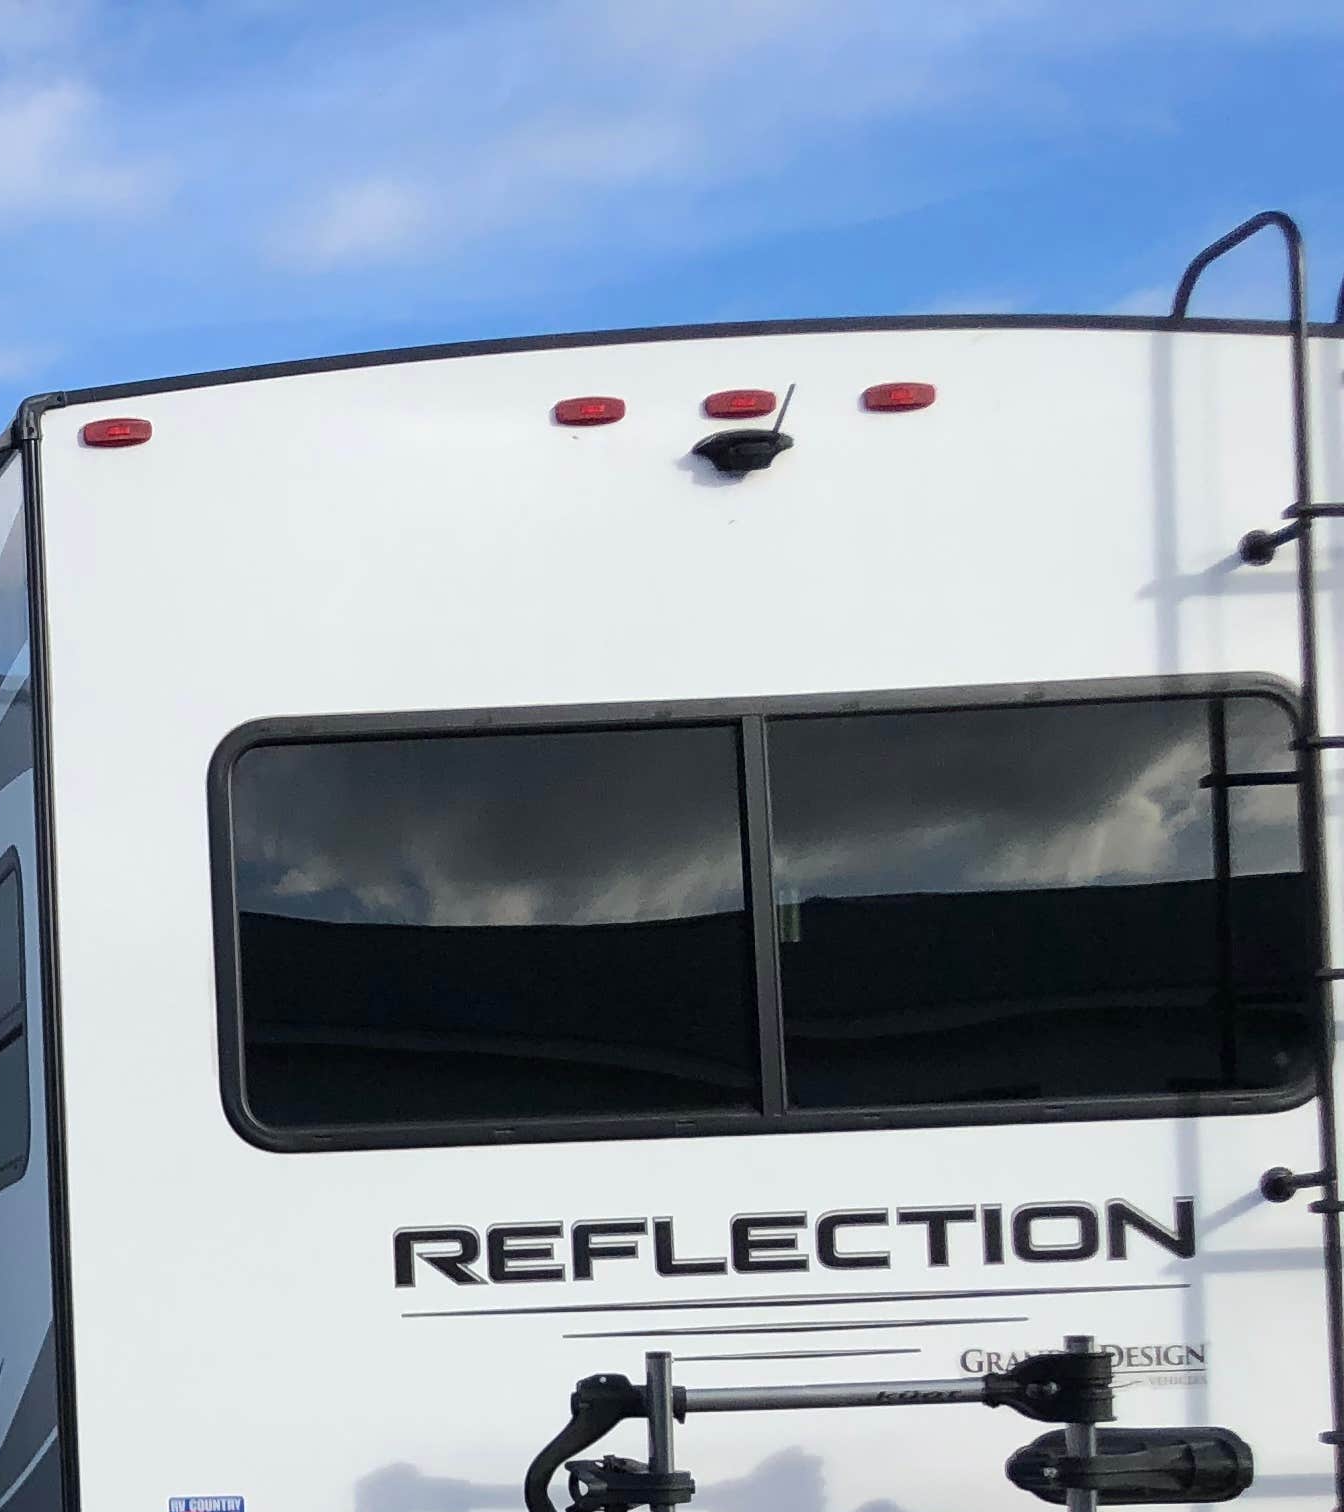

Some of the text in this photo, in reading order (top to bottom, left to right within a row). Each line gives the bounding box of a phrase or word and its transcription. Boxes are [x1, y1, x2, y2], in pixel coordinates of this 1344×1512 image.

[393, 1196, 1196, 1288] REFLECTION
[960, 1348, 1062, 1373] GRA
[189, 1498, 241, 1512] COUNTRY
